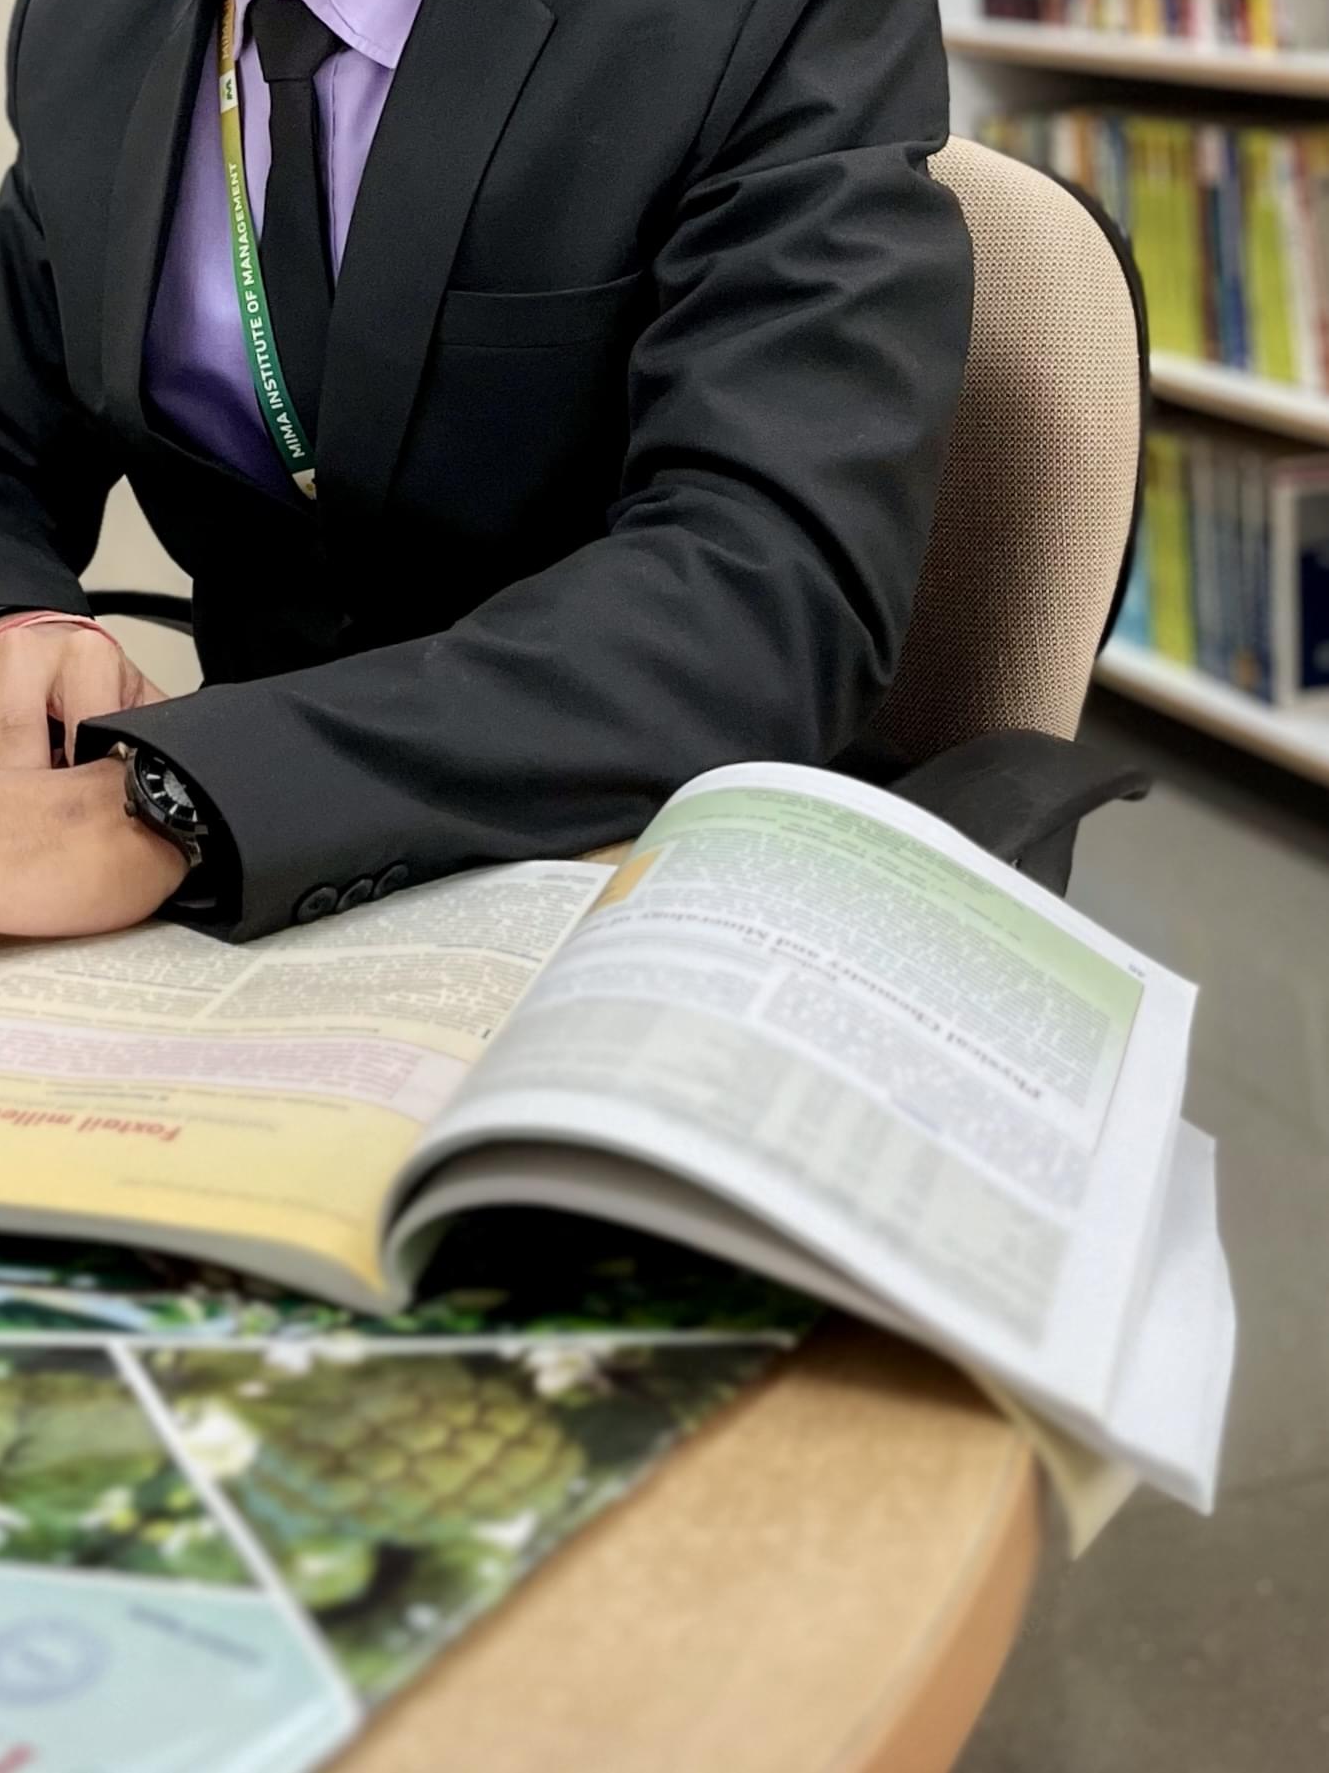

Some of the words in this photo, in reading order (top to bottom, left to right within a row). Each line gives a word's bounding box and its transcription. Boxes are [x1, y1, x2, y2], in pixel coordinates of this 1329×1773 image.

[225, 162, 257, 286] MANAGEMENT
[246, 289, 261, 314] OF
[250, 315, 283, 410] INSTITUTE
[274, 410, 306, 459] MIMA
[77, 1114, 183, 1144] Foxtail
